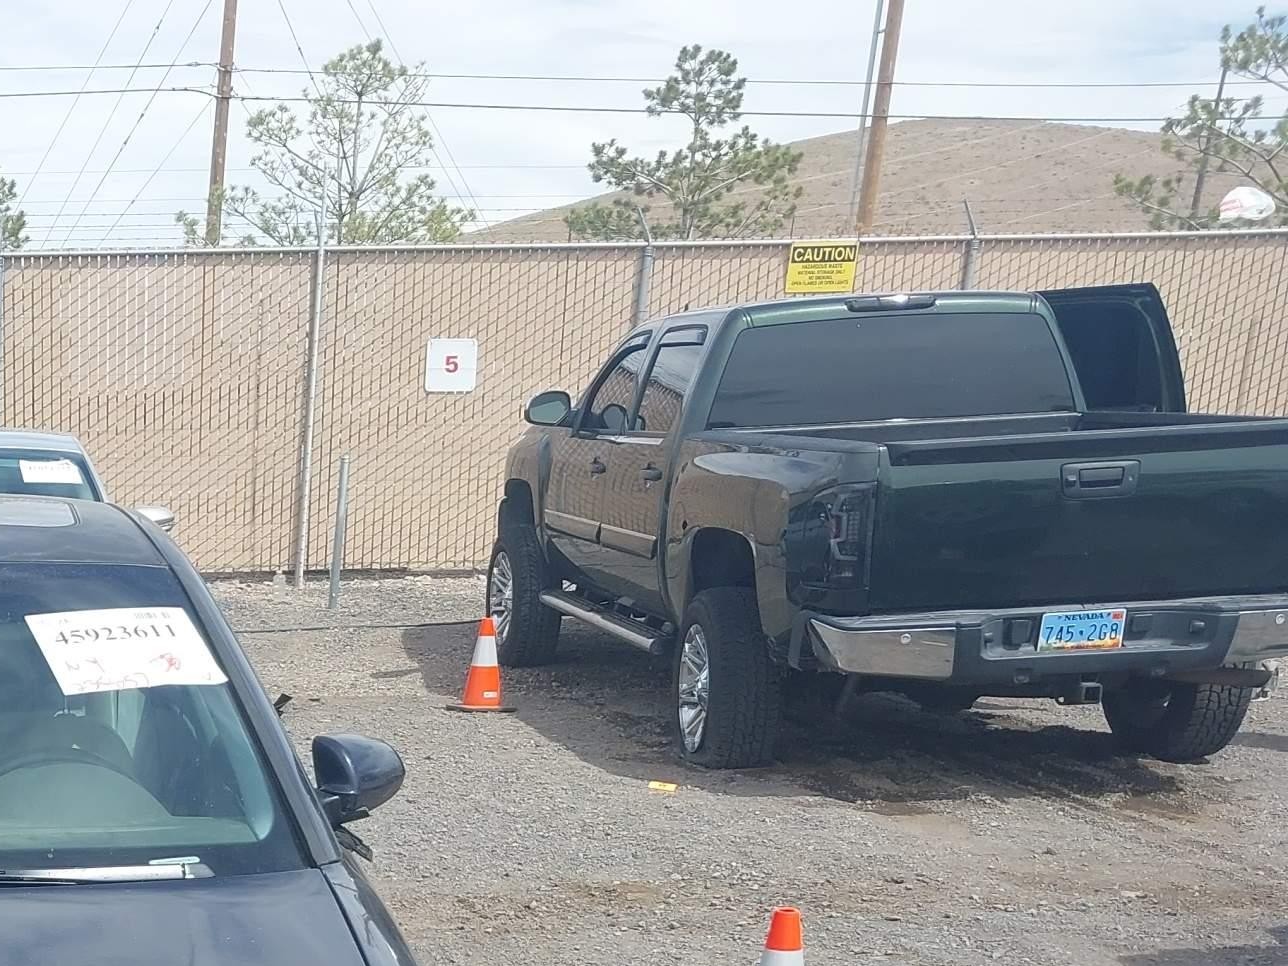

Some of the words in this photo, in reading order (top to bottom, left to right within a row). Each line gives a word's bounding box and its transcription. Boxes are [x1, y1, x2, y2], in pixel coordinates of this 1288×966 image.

[794, 247, 855, 262] CAUTION
[445, 356, 459, 373] 5
[1064, 612, 1105, 621] NEVADA
[55, 623, 177, 645] 45923611
